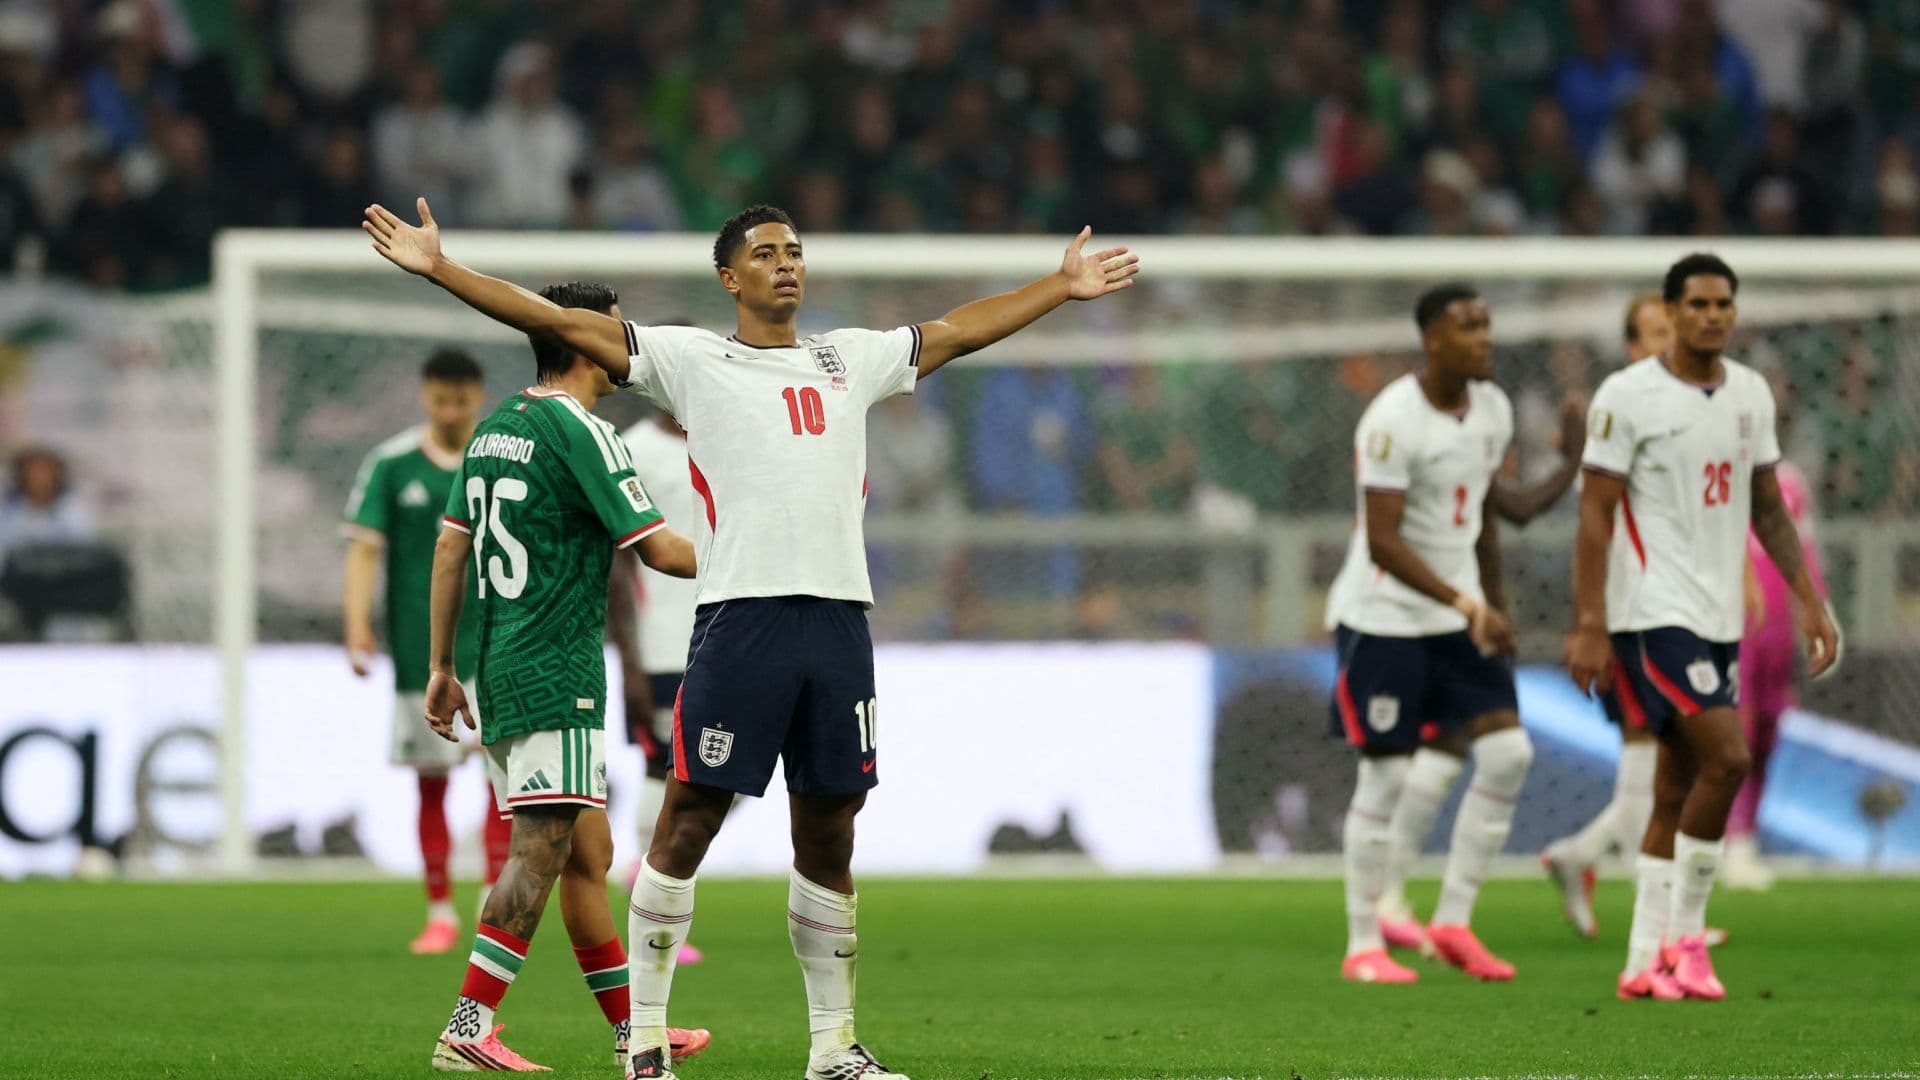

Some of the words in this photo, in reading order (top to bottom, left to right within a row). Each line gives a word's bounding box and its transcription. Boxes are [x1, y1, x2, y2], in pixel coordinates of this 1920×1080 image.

[782, 386, 826, 435] 10
[1703, 461, 1732, 507] 26
[466, 476, 528, 599] 25
[855, 697, 877, 752] 10
